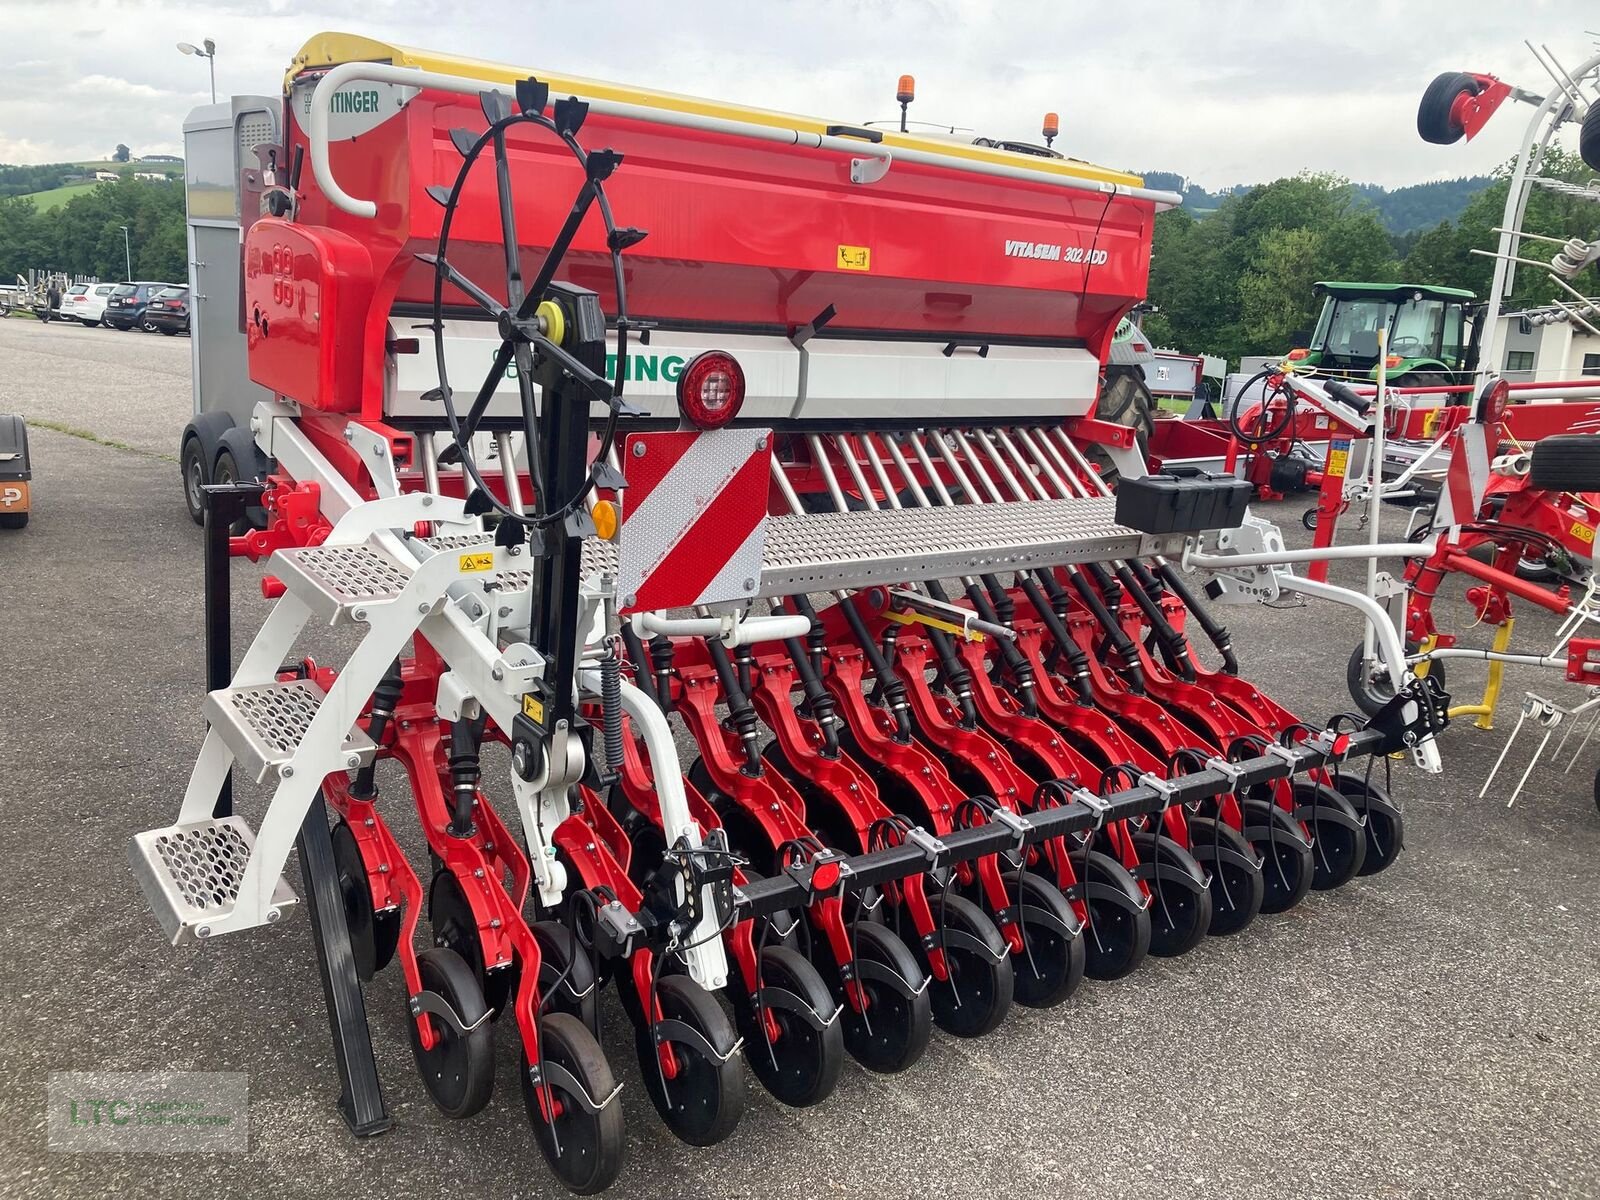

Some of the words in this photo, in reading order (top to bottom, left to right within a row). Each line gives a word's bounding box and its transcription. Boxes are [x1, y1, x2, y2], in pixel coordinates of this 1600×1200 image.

[1004, 240, 1062, 261] VITASEM
[1063, 246, 1085, 263] 302
[1083, 249, 1108, 265] ADD
